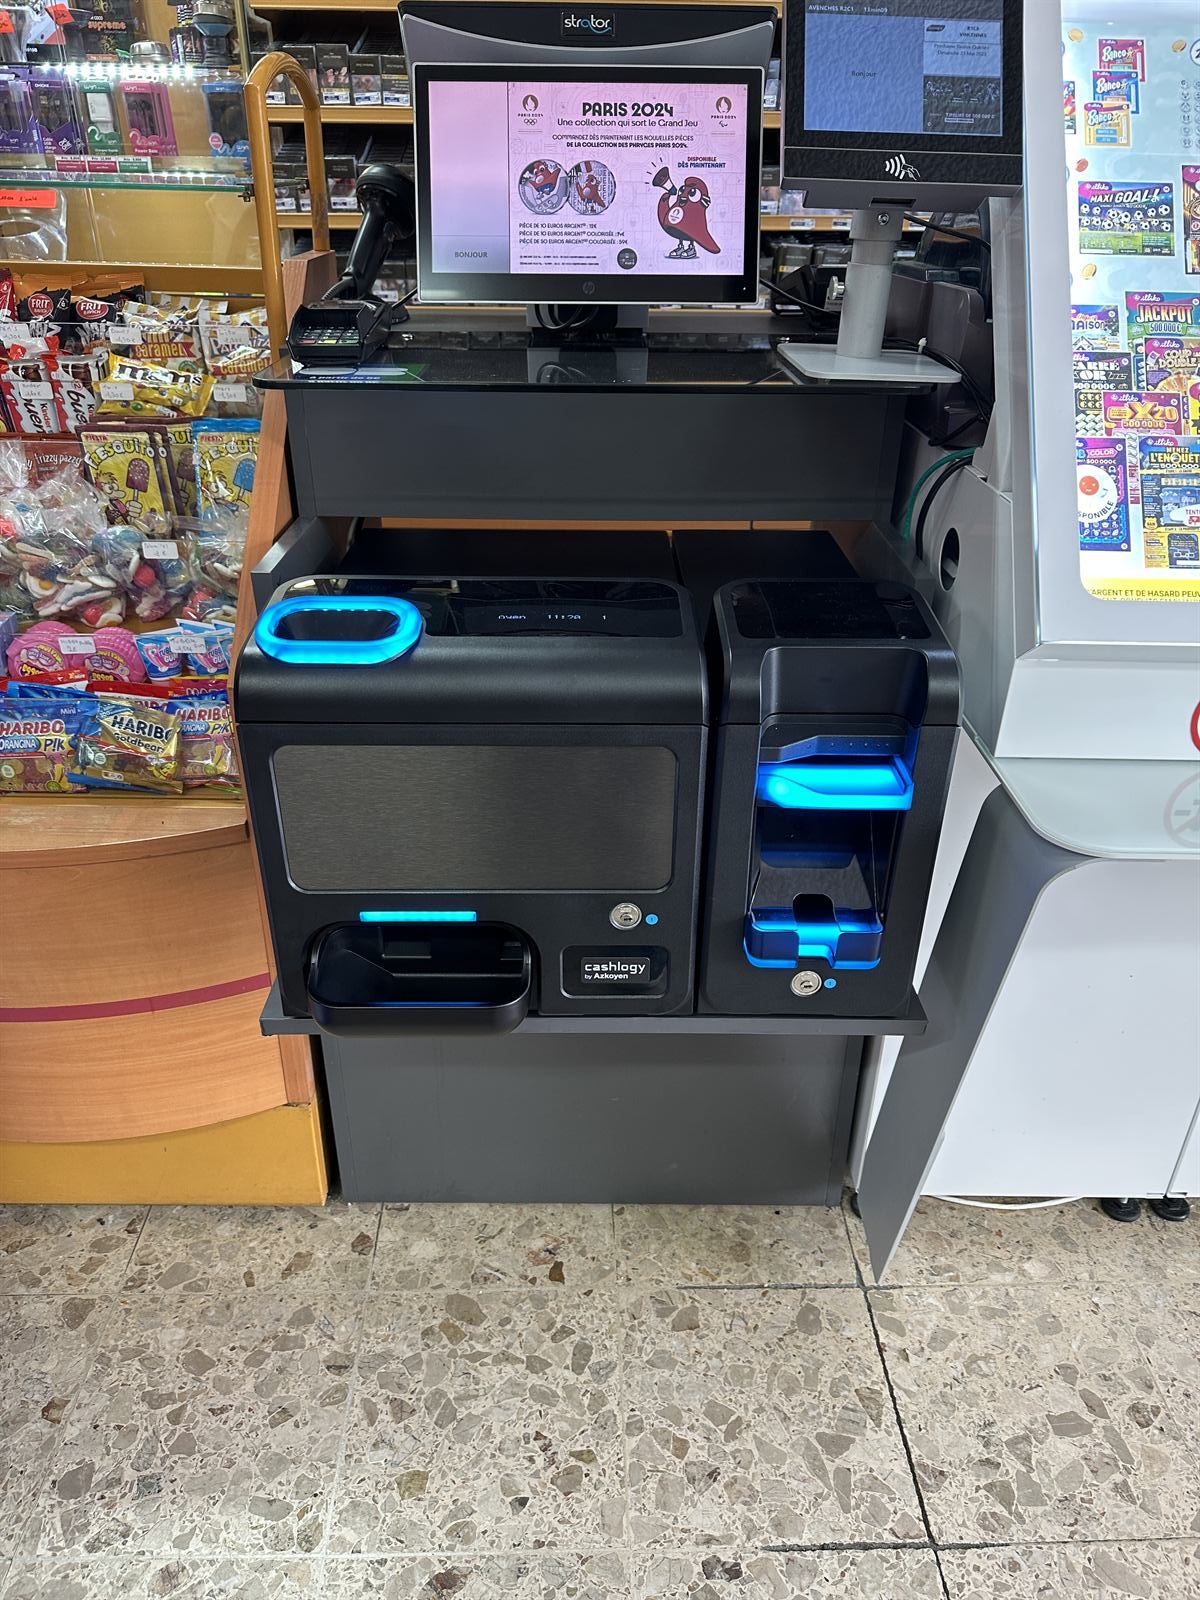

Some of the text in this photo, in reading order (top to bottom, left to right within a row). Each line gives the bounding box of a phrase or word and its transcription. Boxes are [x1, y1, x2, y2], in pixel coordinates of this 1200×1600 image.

[88, 20, 126, 31] supreme
[564, 14, 612, 33] strator
[852, 70, 876, 78] Bonjour
[1096, 78, 1120, 93] Banco
[582, 102, 674, 117] PARIS 2024
[618, 119, 630, 128] qui
[658, 119, 683, 127] Grand
[1088, 110, 1112, 126] Banco
[1090, 194, 1113, 204] MAXI
[1141, 294, 1161, 302] illiko
[31, 300, 50, 308] FRIT
[81, 302, 101, 310] FRIT
[1136, 304, 1194, 325] JACKPOT
[1150, 323, 1162, 333] 500
[1163, 323, 1176, 333] 000
[136, 342, 184, 358] caramel
[1164, 350, 1192, 360] COUP
[1158, 358, 1195, 369] DOUBLE
[1119, 394, 1139, 402] illiko
[67, 390, 88, 424] bue
[1123, 420, 1140, 428] 500
[1152, 438, 1174, 447] illiko
[34, 453, 82, 468] frizzy pazzy
[84, 440, 155, 470] FRESQUITO
[1182, 590, 1200, 598] PEUV
[0, 720, 65, 736] HARIBO
[0, 738, 66, 752] ORANGINA P!K
[584, 961, 645, 974] cashlogy
